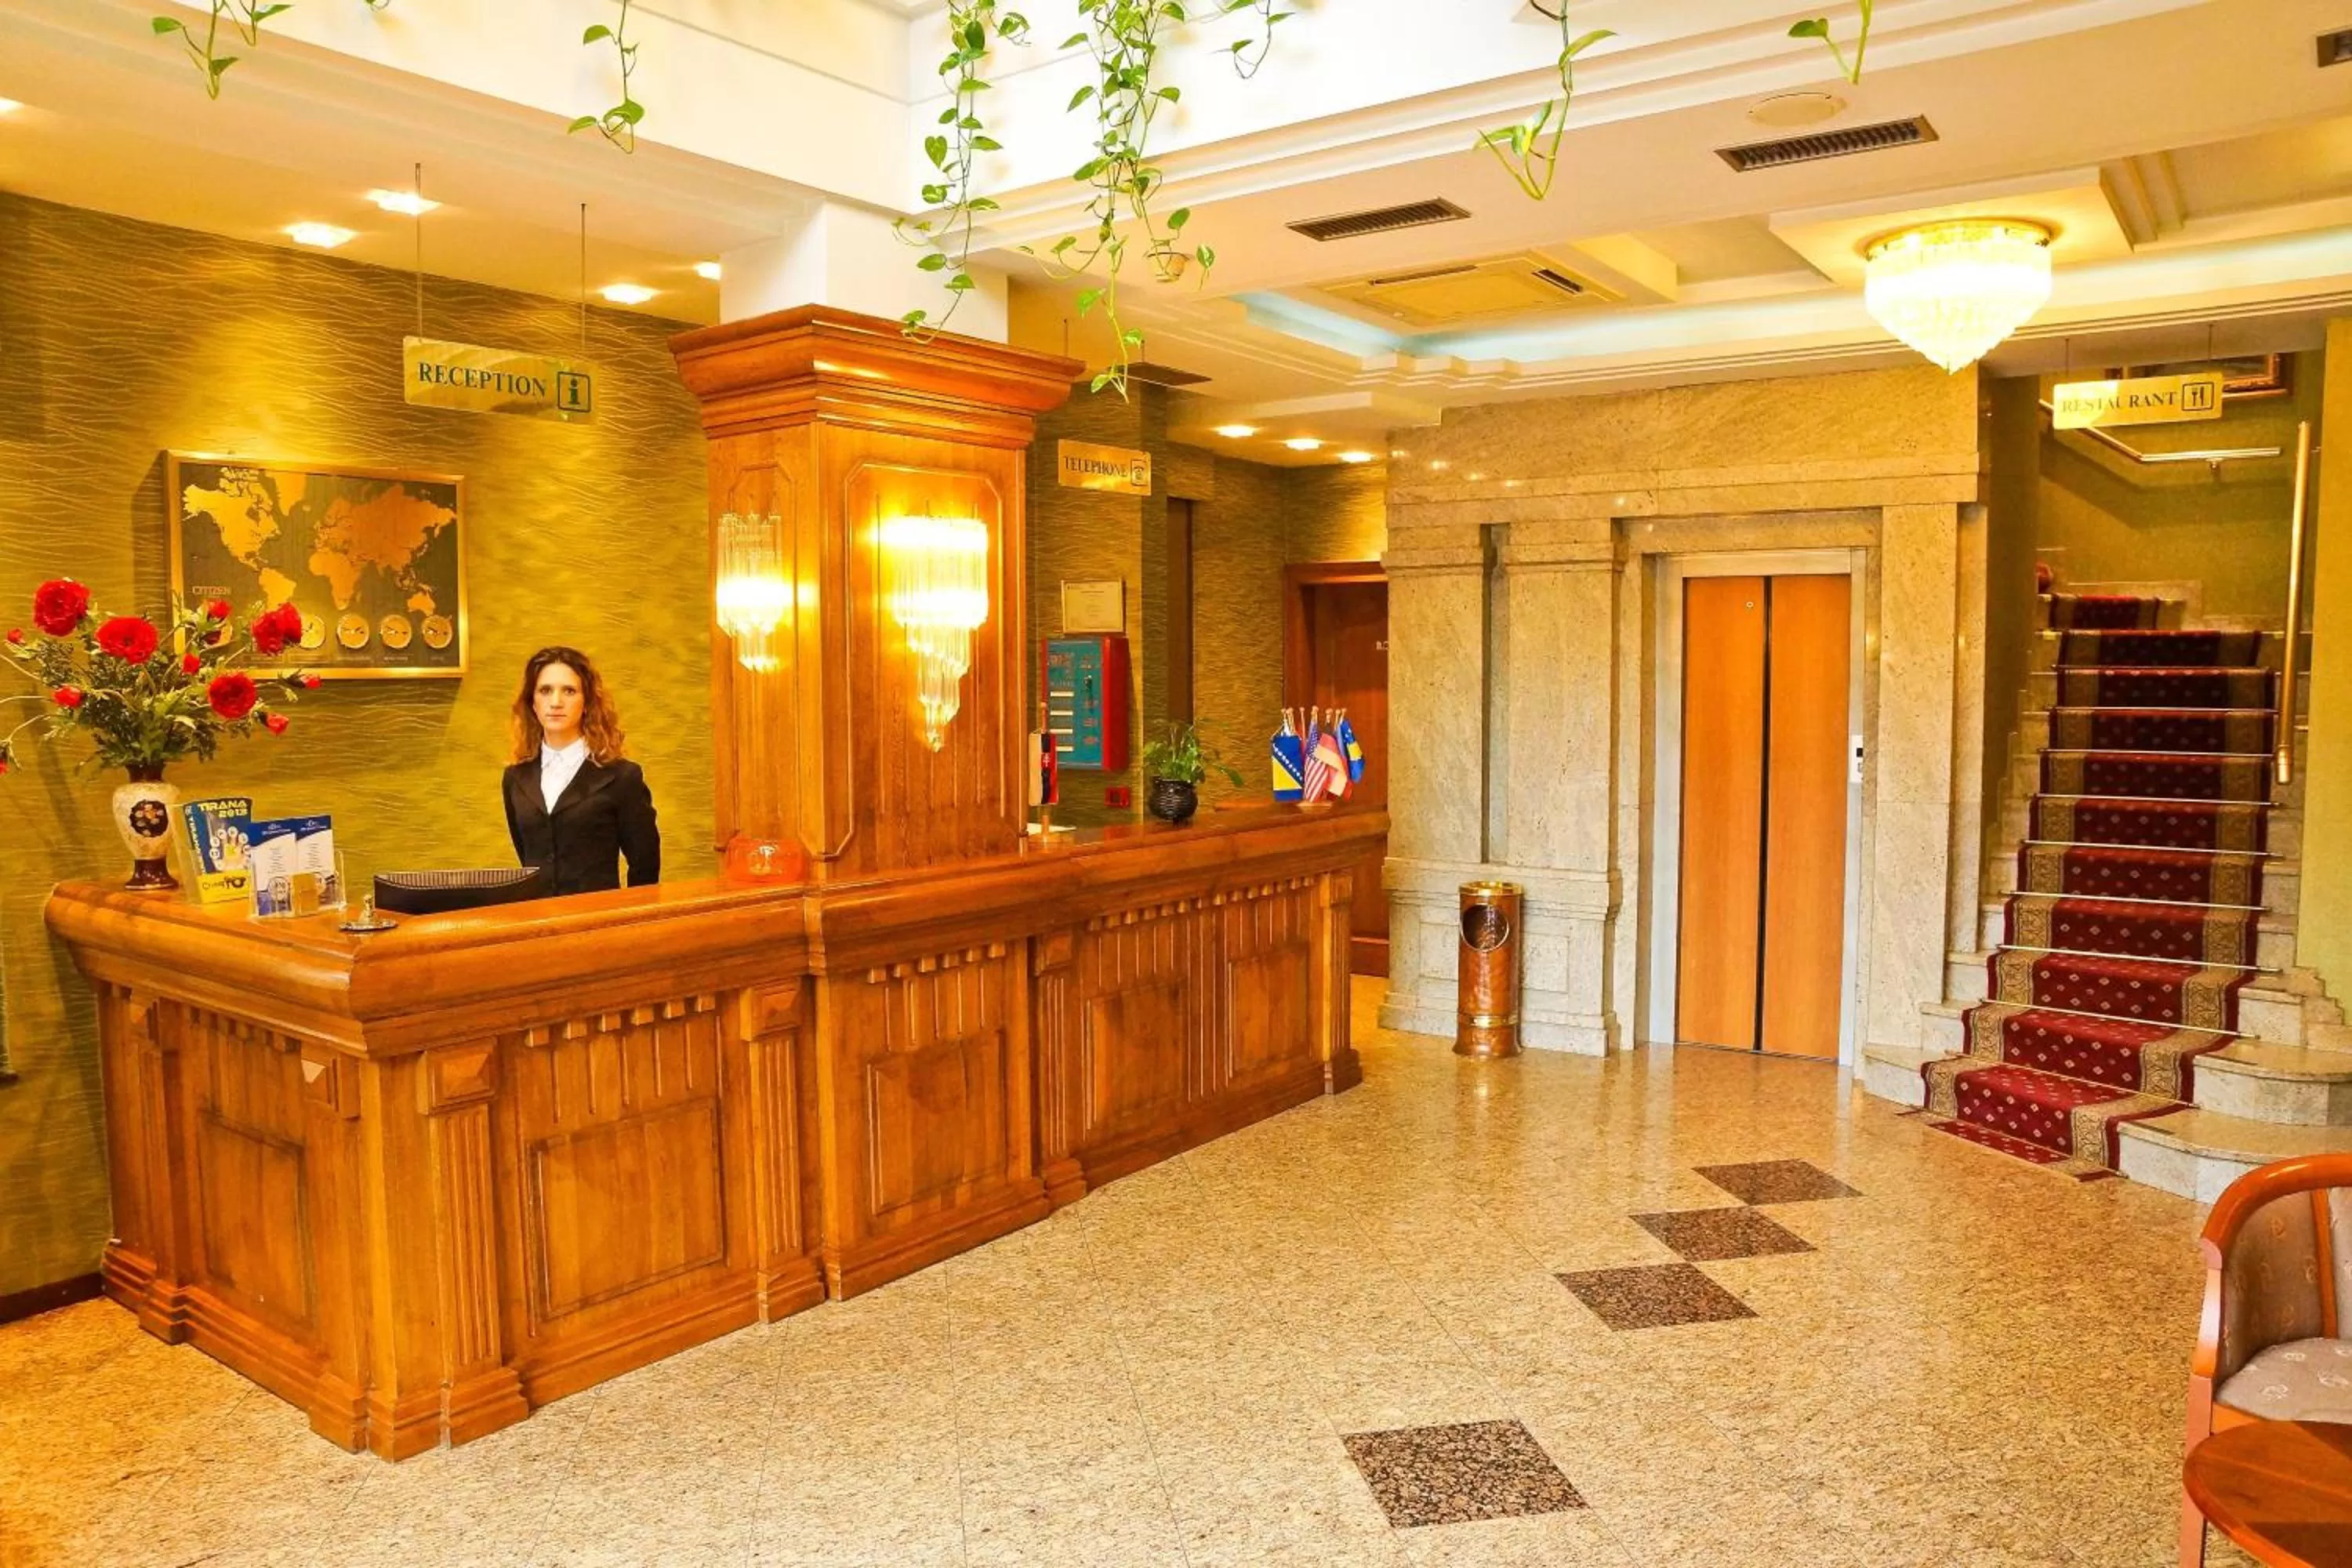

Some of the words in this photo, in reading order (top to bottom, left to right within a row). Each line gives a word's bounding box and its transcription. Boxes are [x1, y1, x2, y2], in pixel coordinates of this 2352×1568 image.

[418, 361, 546, 397] RECEPTION
[2061, 391, 2179, 413] RESTAURANT
[1063, 456, 1128, 477] TELEPHONE
[197, 800, 247, 811] TIRANA
